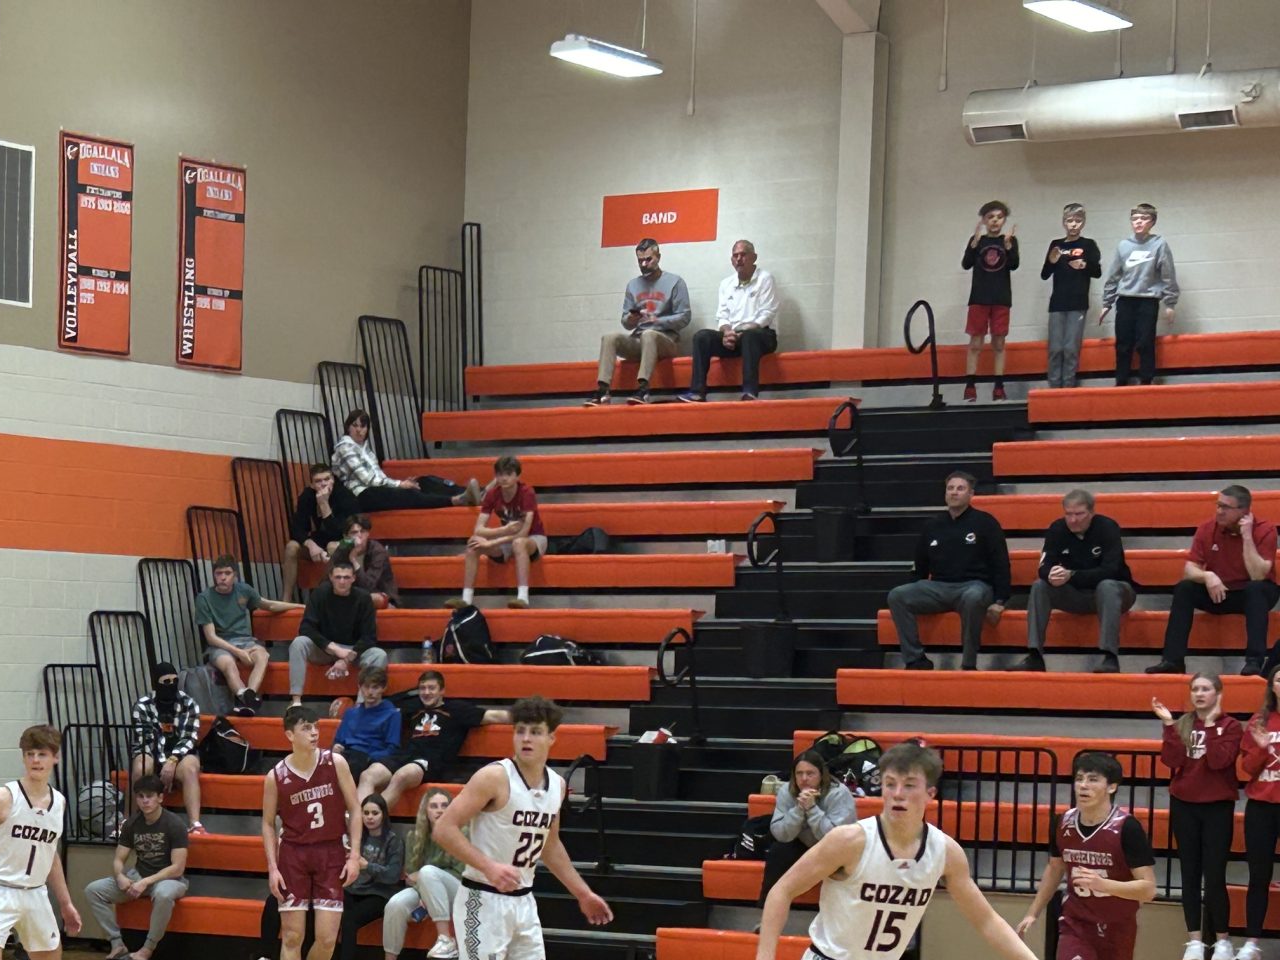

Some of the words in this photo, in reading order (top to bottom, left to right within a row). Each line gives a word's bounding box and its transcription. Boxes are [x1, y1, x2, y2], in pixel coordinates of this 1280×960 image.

[642, 212, 677, 225] BAND
[181, 257, 195, 356] WRESTLING
[307, 802, 325, 829] 3
[11, 824, 58, 844] COZAD
[25, 844, 37, 876] 1
[512, 832, 544, 868] 22
[859, 882, 932, 907] COZAD
[864, 909, 908, 952] 15
